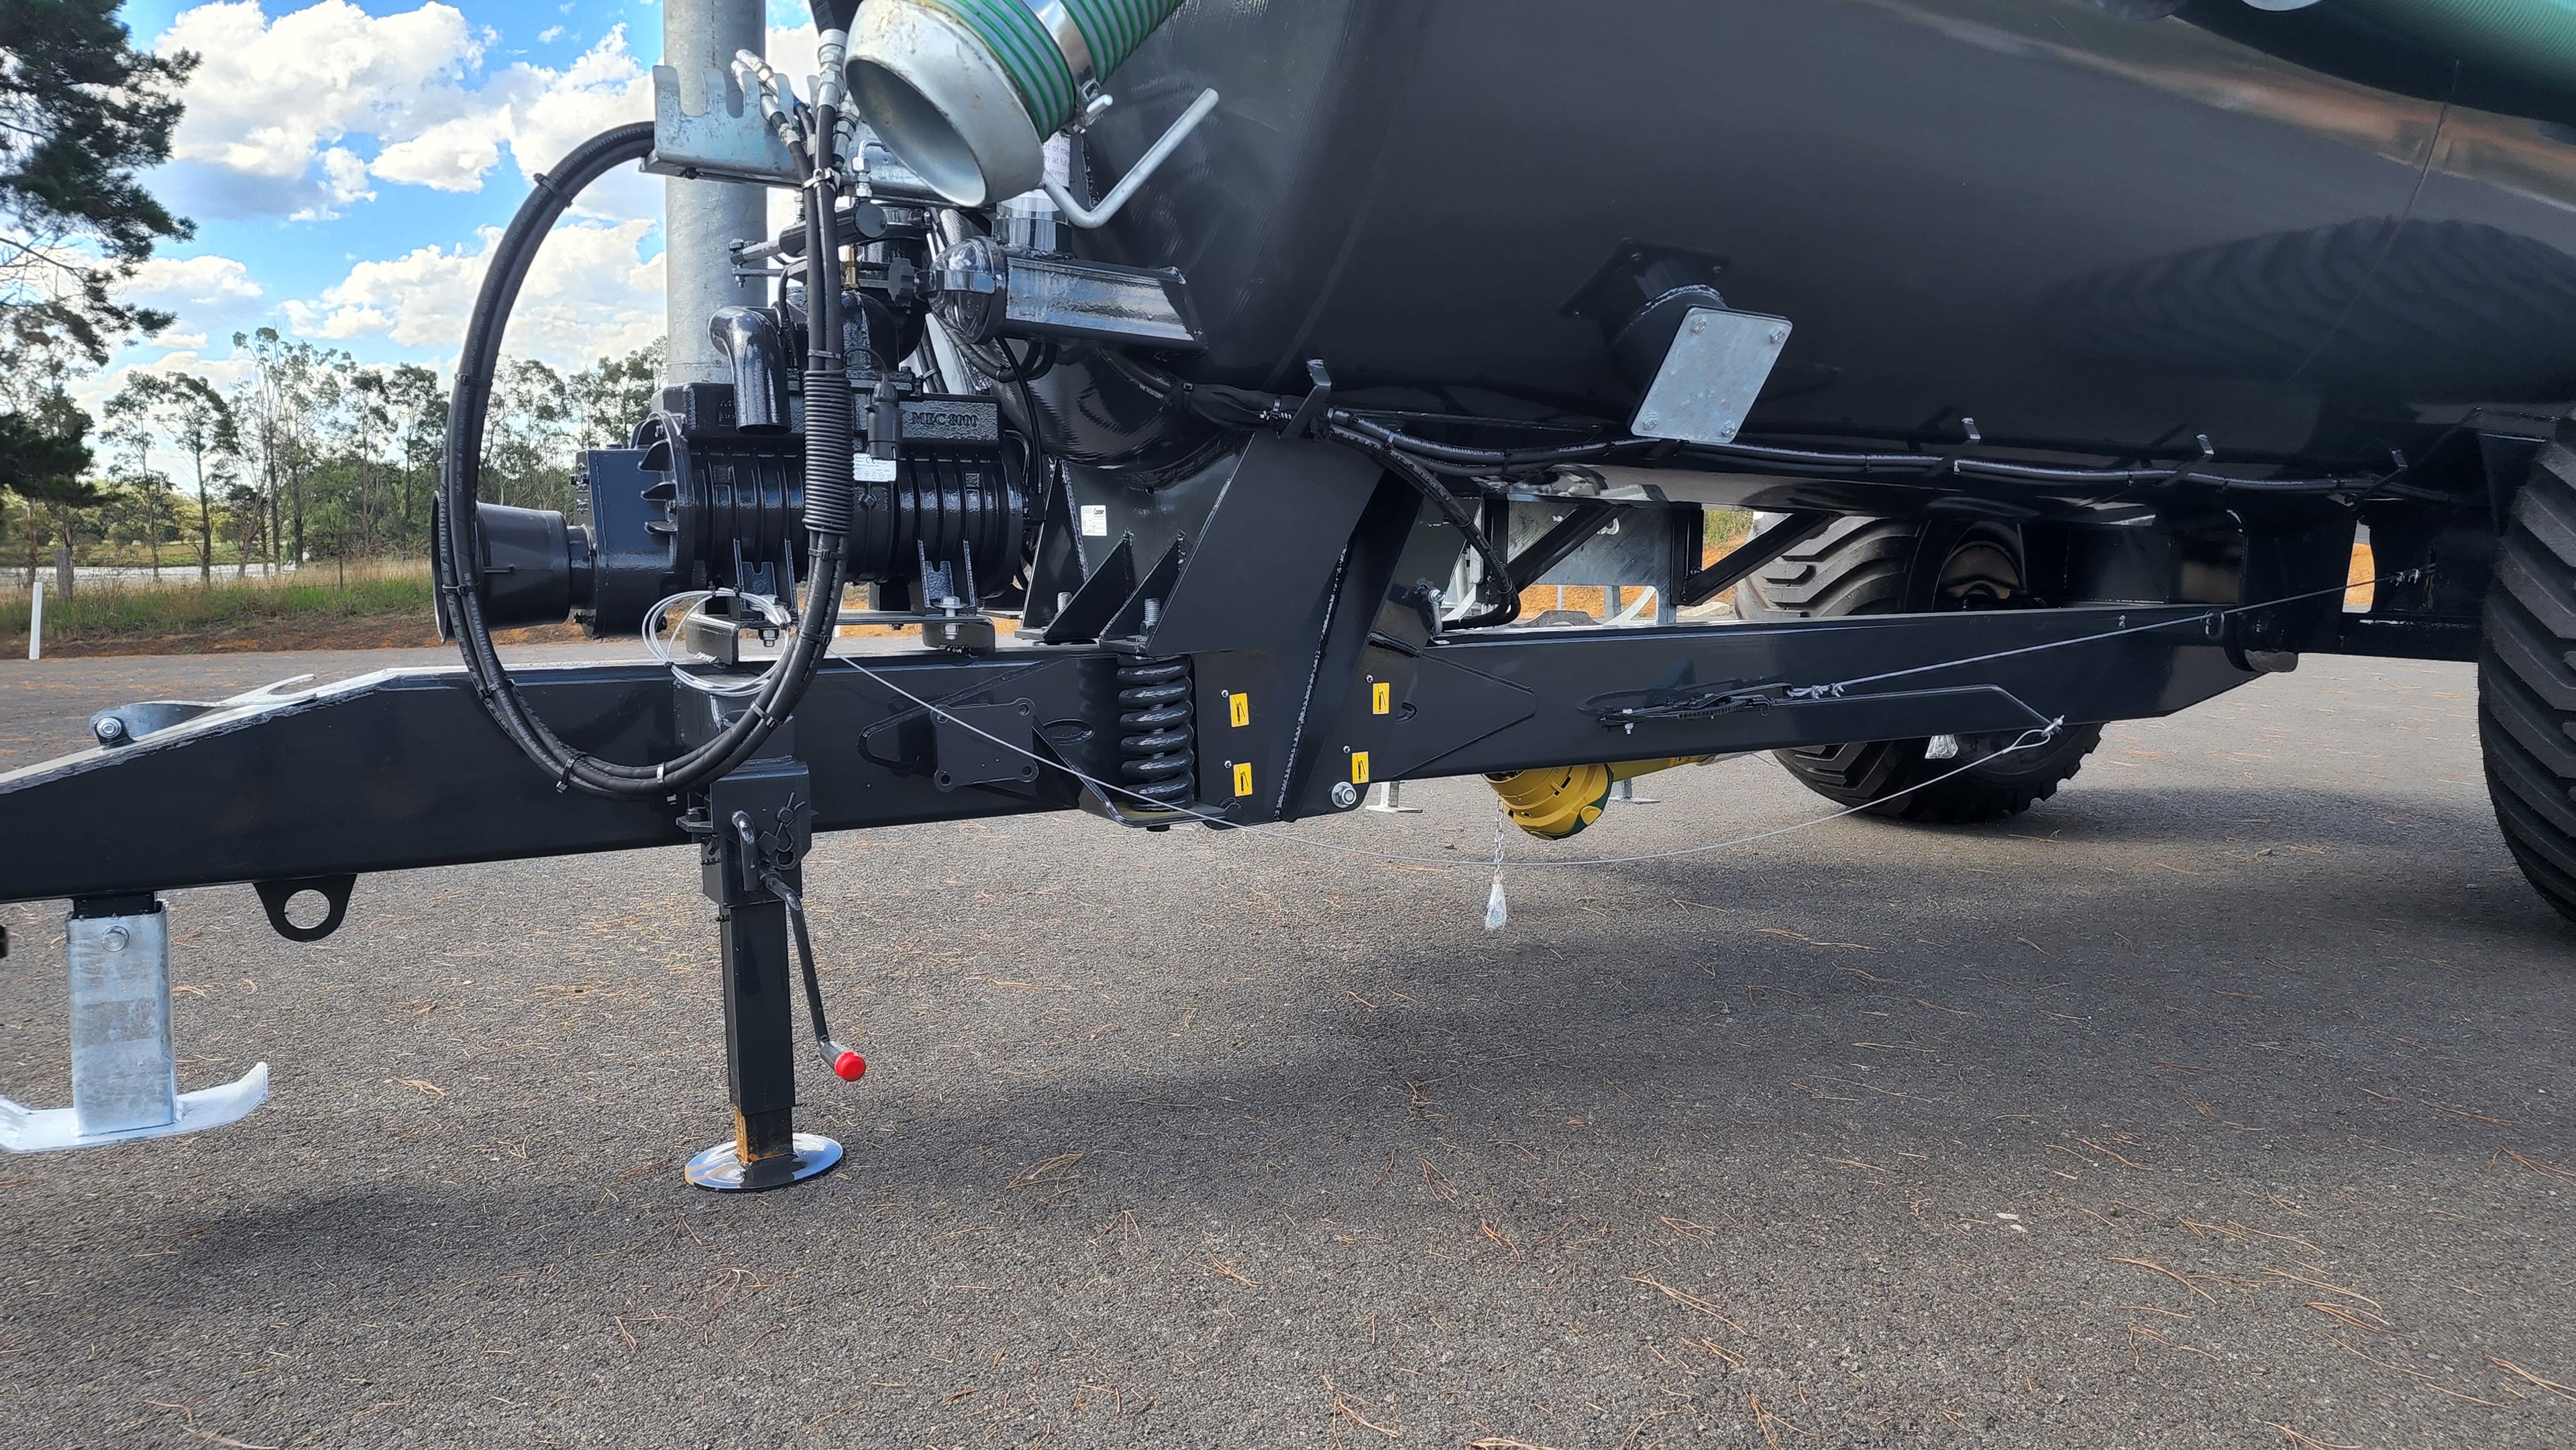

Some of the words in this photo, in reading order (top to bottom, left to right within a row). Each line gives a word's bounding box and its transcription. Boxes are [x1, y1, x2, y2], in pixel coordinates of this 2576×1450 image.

[911, 412, 946, 425] MEC
[948, 414, 979, 427] 8000
[471, 606, 492, 663] ROCKMASTER/2SC
